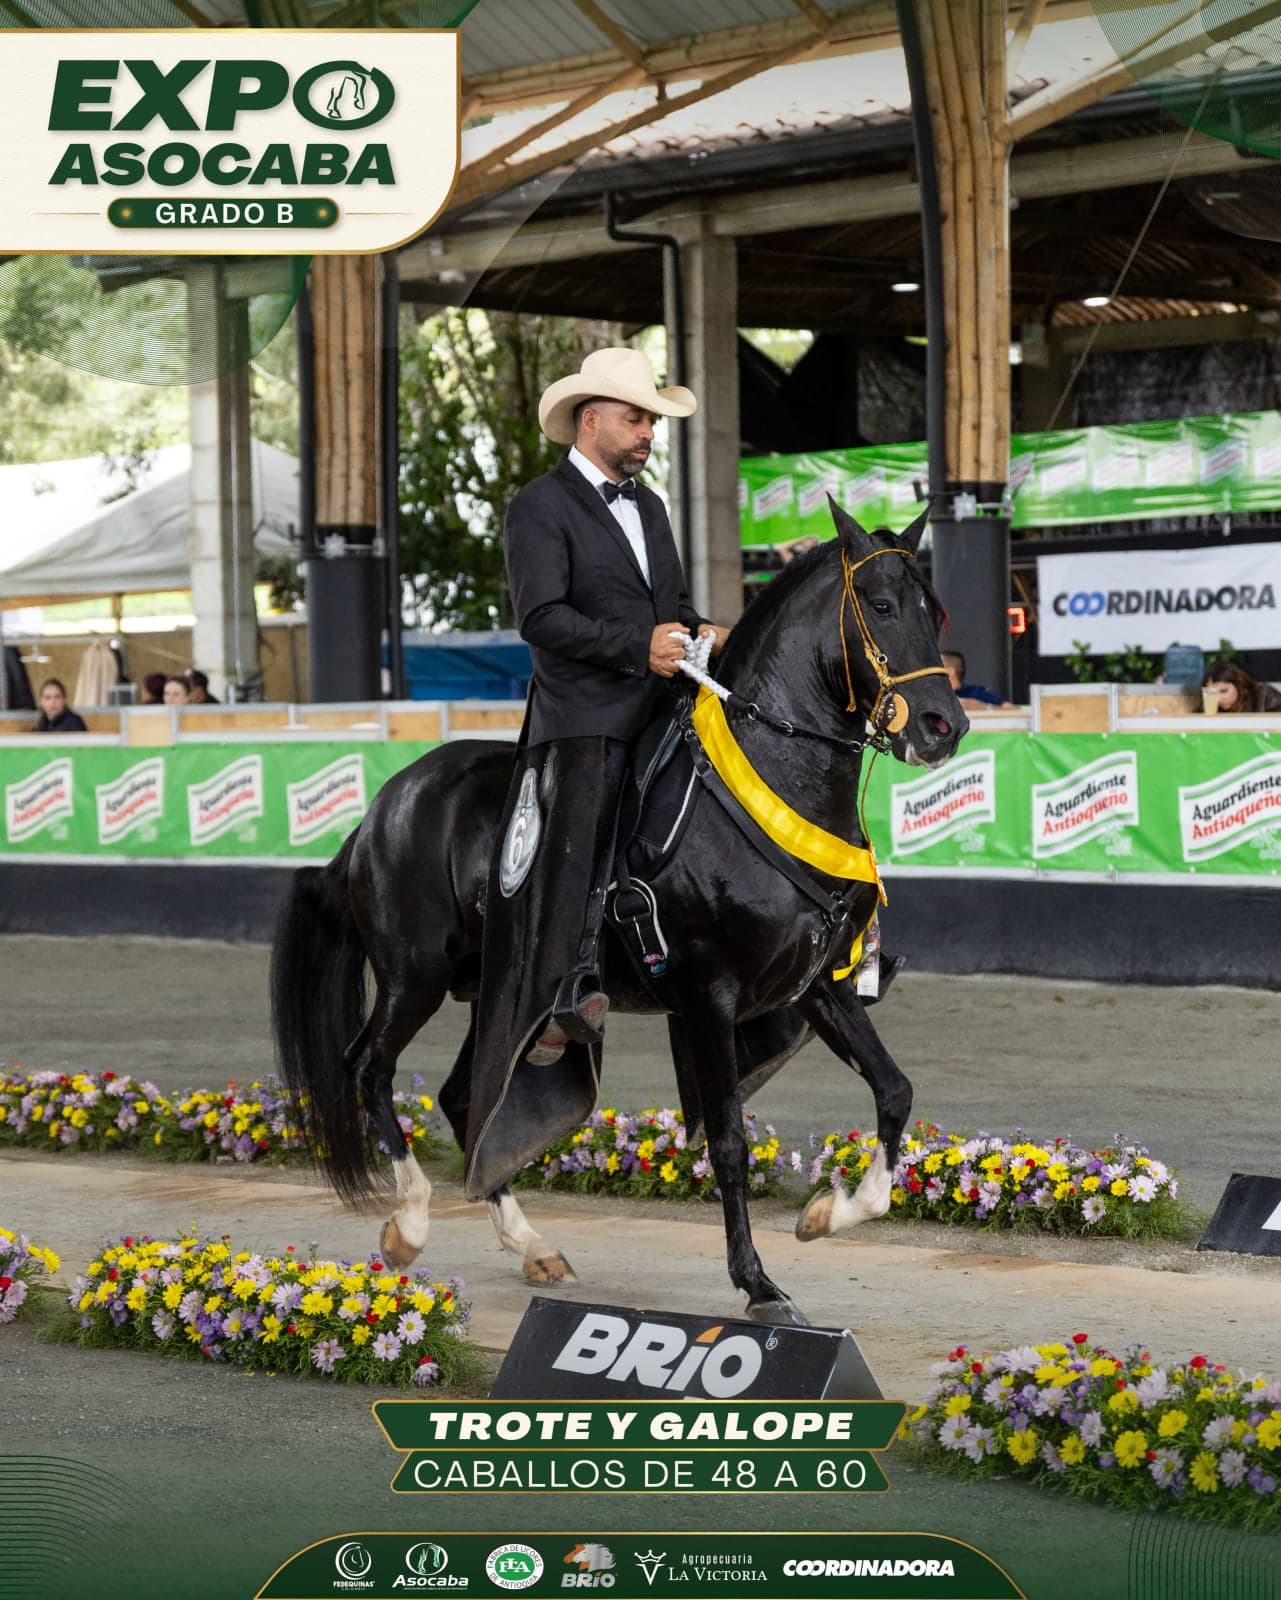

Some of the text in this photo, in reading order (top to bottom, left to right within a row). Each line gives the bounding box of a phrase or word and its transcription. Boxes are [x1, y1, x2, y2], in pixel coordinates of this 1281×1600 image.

[1052, 583, 1276, 617] COORDINADORA
[903, 773, 984, 816] Aguardiente
[1044, 774, 1127, 818] Aguardiente
